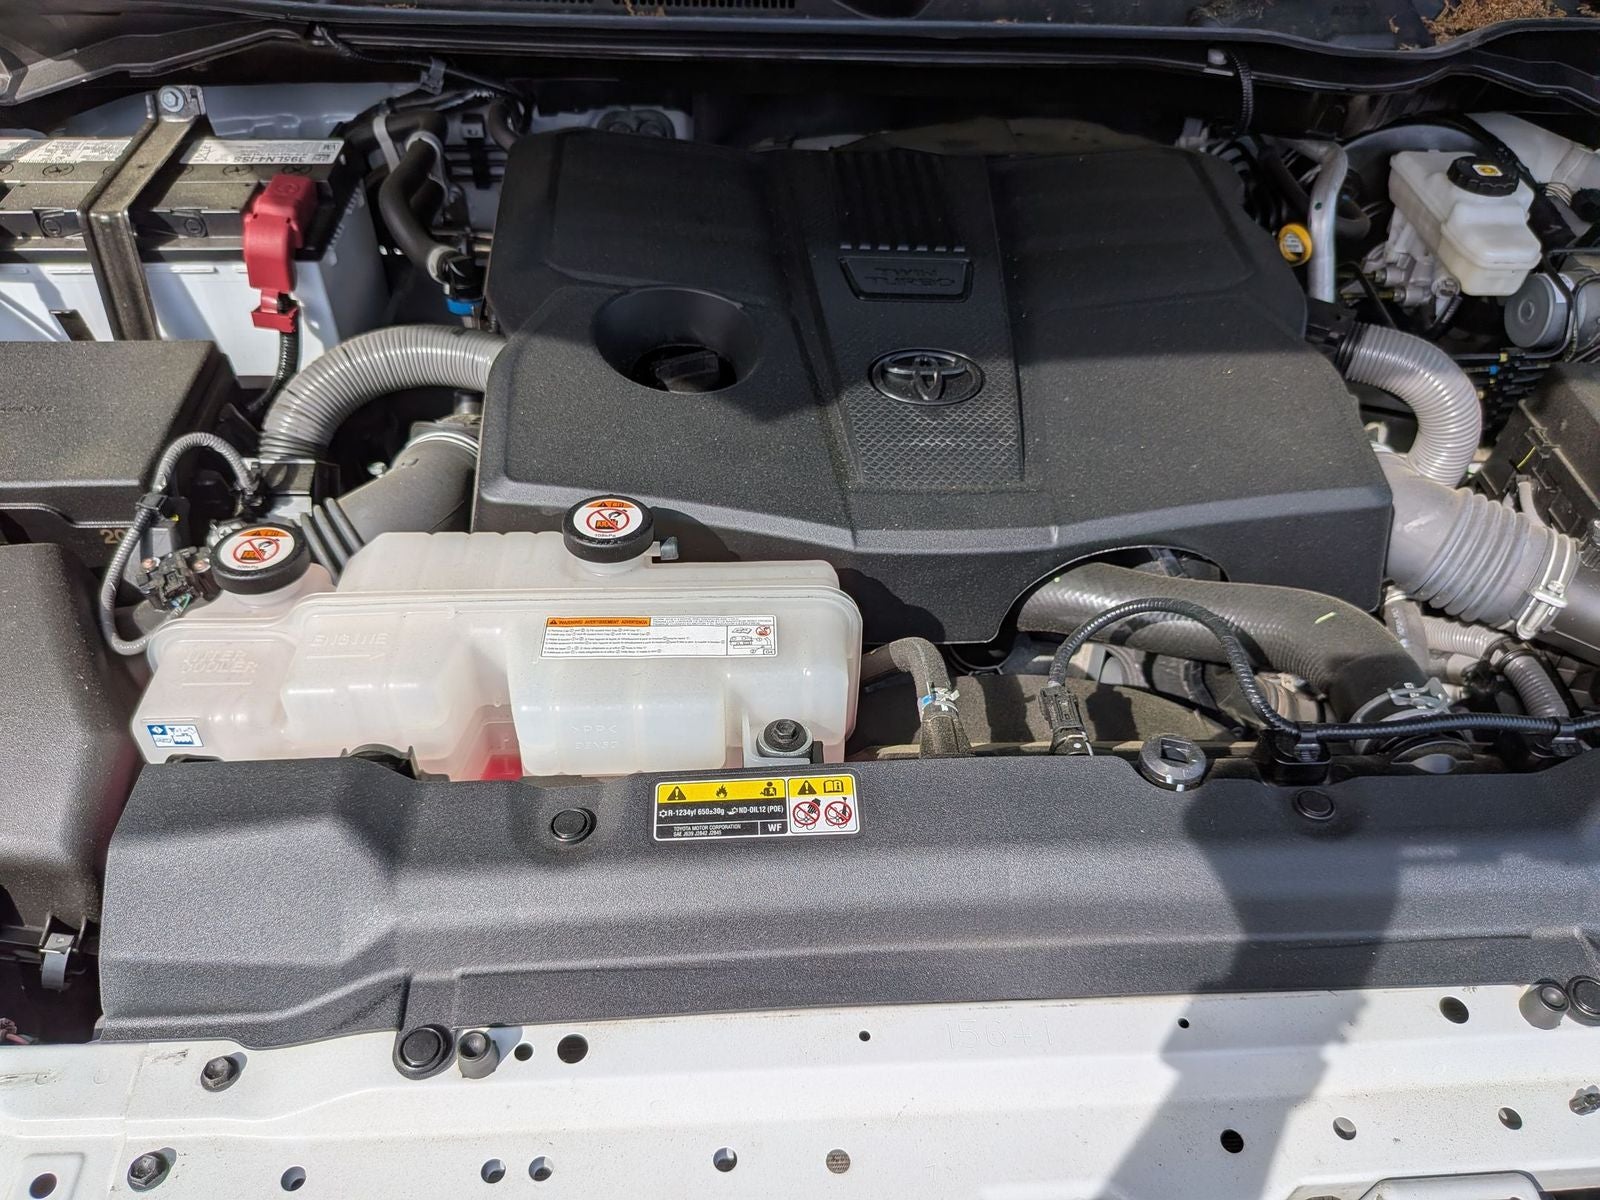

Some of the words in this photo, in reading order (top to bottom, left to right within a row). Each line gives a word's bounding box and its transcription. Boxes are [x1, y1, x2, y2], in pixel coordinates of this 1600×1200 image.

[310, 632, 390, 647] ENGINE
[668, 808, 697, 817] R-1234yf
[697, 807, 725, 816] 650±30g
[767, 804, 784, 814] (POE)
[709, 823, 741, 831] CORPORATION
[768, 823, 782, 832] WF
